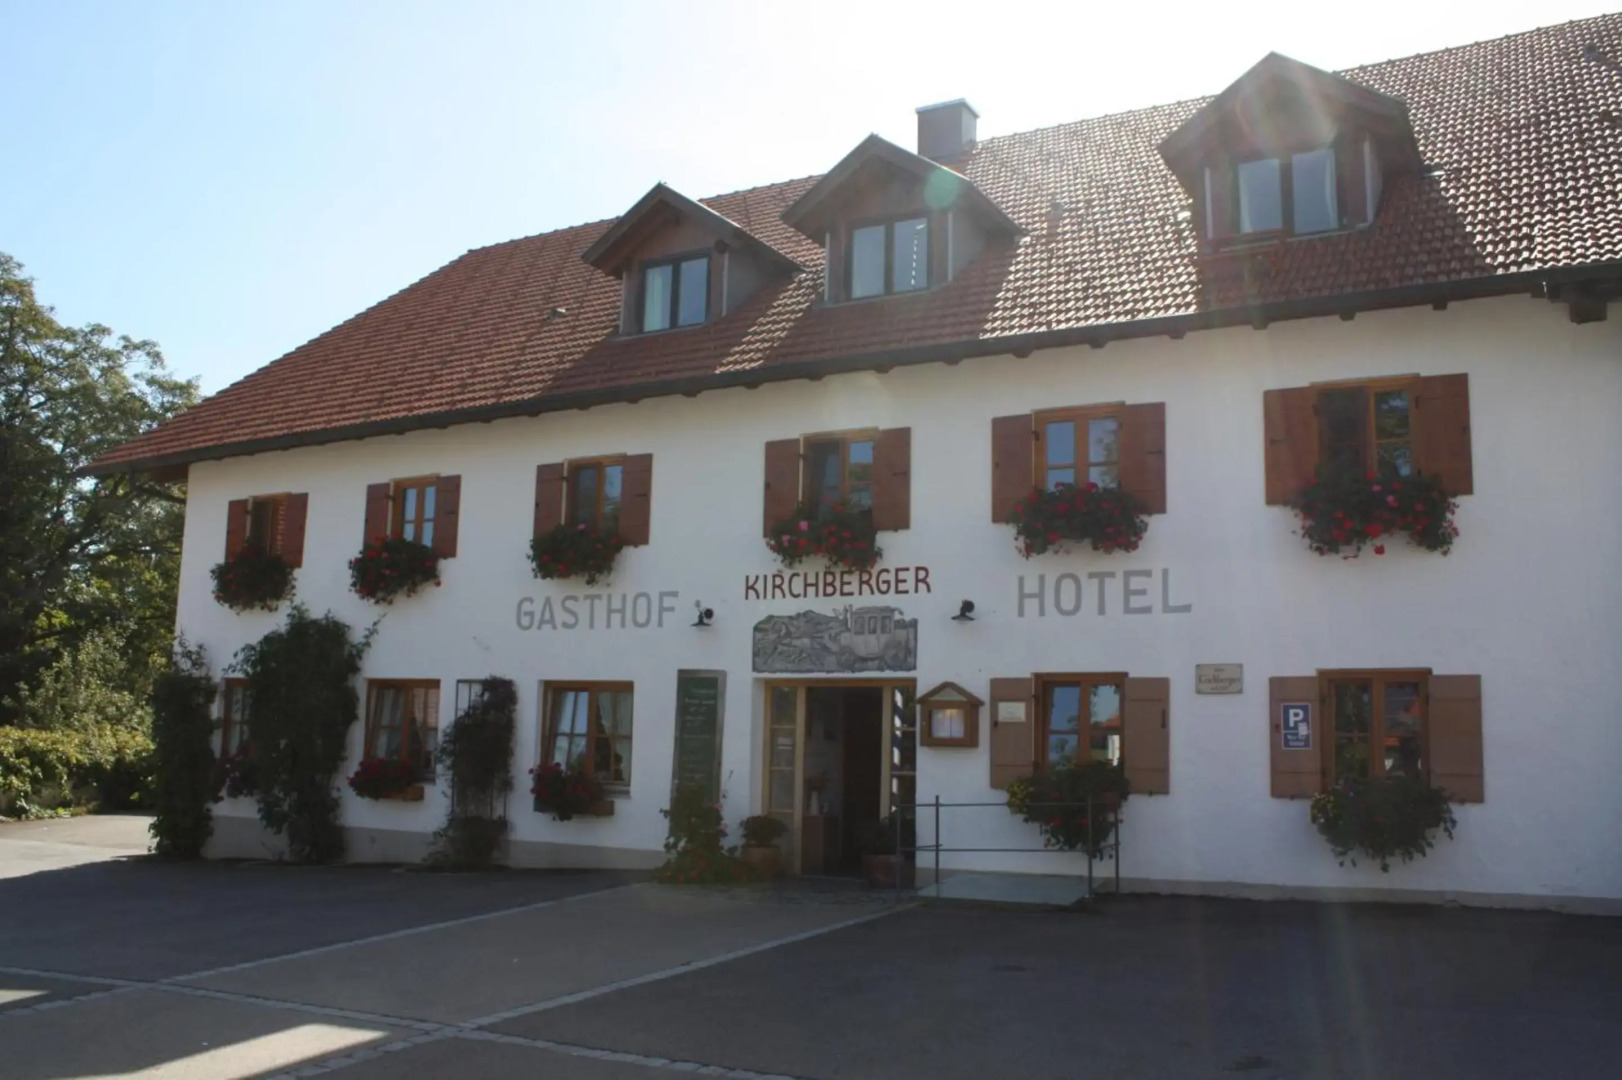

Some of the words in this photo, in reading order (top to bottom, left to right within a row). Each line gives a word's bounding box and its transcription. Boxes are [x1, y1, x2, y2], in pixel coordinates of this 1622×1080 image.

[744, 566, 932, 600] KIRCHBERGER
[1017, 568, 1192, 618] HOTEL
[515, 590, 679, 631] GASTHOF
[1289, 708, 1304, 727] P
